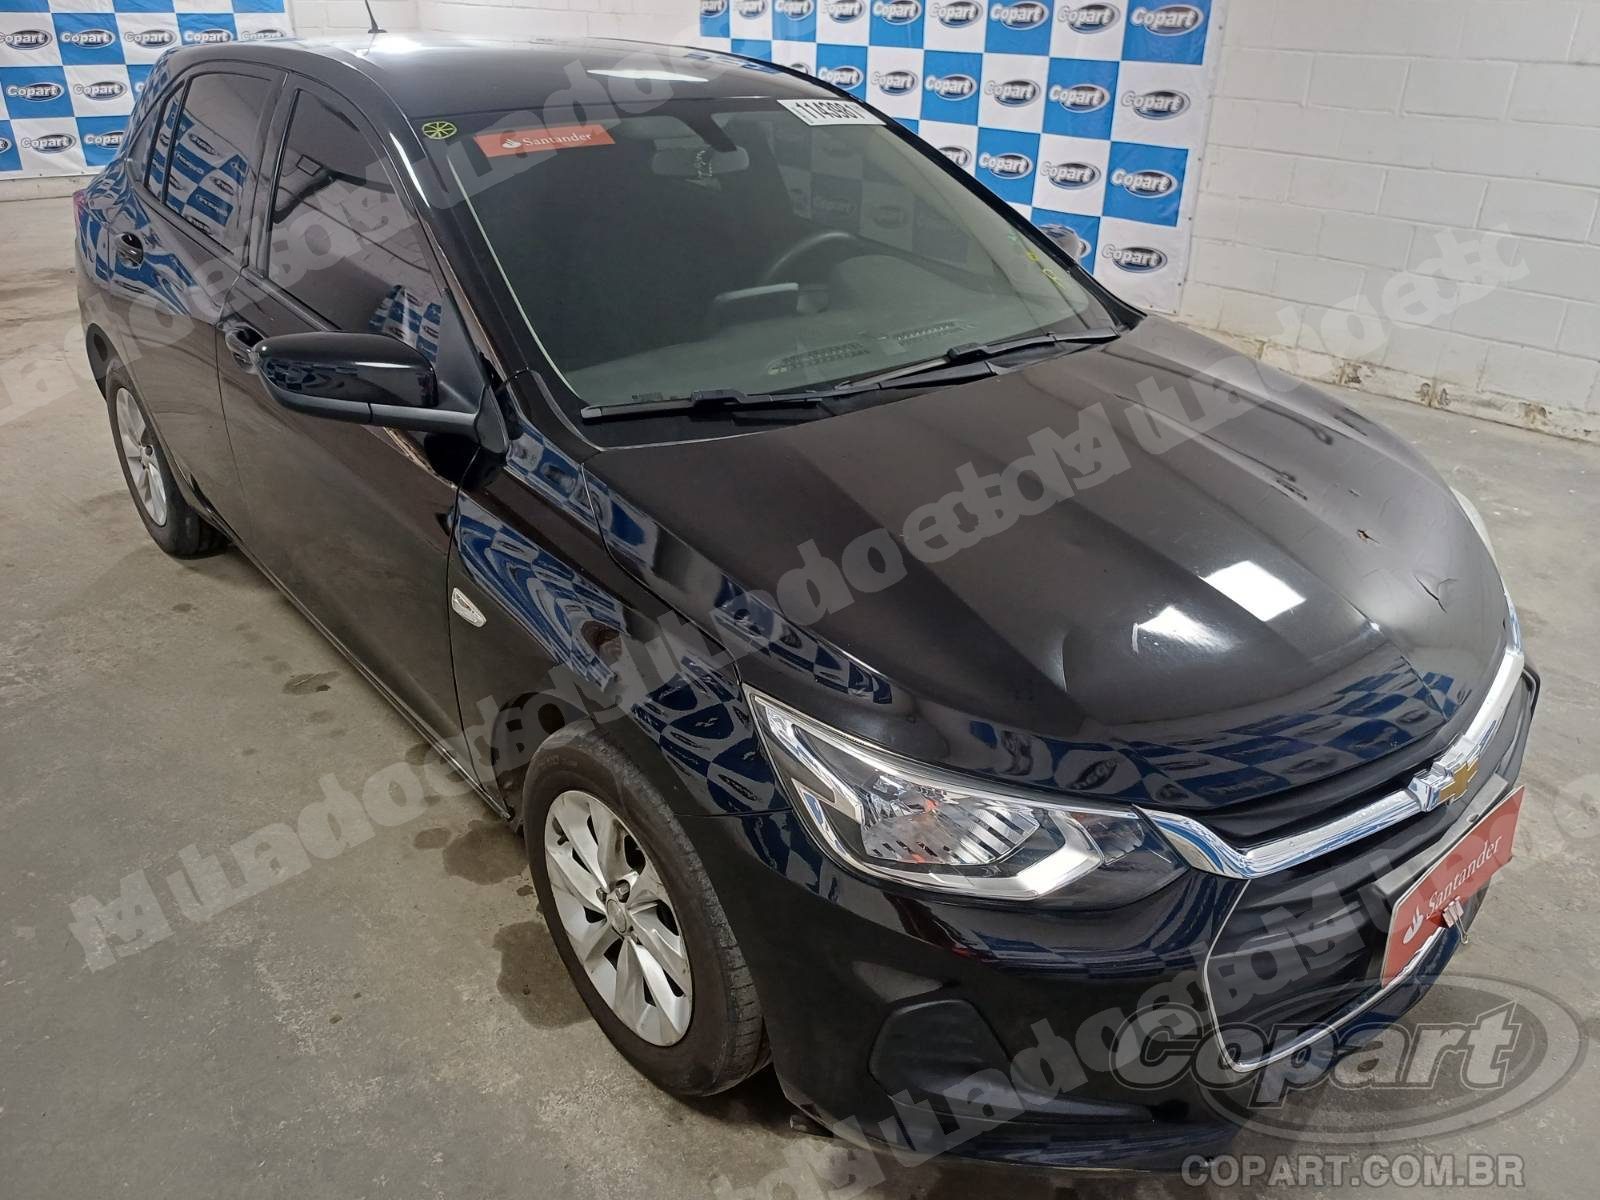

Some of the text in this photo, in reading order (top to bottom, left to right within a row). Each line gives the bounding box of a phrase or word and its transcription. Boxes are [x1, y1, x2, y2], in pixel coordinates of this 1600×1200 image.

[873, 2, 915, 20] Copart
[929, 3, 975, 21] Copart
[990, 4, 1045, 24] Copart
[1057, 6, 1111, 29] Copart
[1131, 8, 1195, 31] Copart
[61, 31, 108, 45] Copart
[124, 31, 170, 45] Copart
[184, 31, 228, 43] Copart
[818, 67, 858, 85] Copart
[871, 72, 914, 91] Copart
[925, 76, 973, 96] Copart
[7, 85, 58, 99] Copart
[74, 84, 120, 97] Copart
[984, 81, 1033, 102] Copart
[1049, 85, 1105, 107] Copart
[1122, 91, 1181, 114] Copart
[21, 137, 69, 150] Copart
[523, 132, 593, 146] Santander
[979, 152, 1025, 174] Copart
[1040, 162, 1091, 185] Copart
[1111, 169, 1169, 192] Copart
[1101, 245, 1159, 267] Copart
[1426, 836, 1502, 919] Santander
